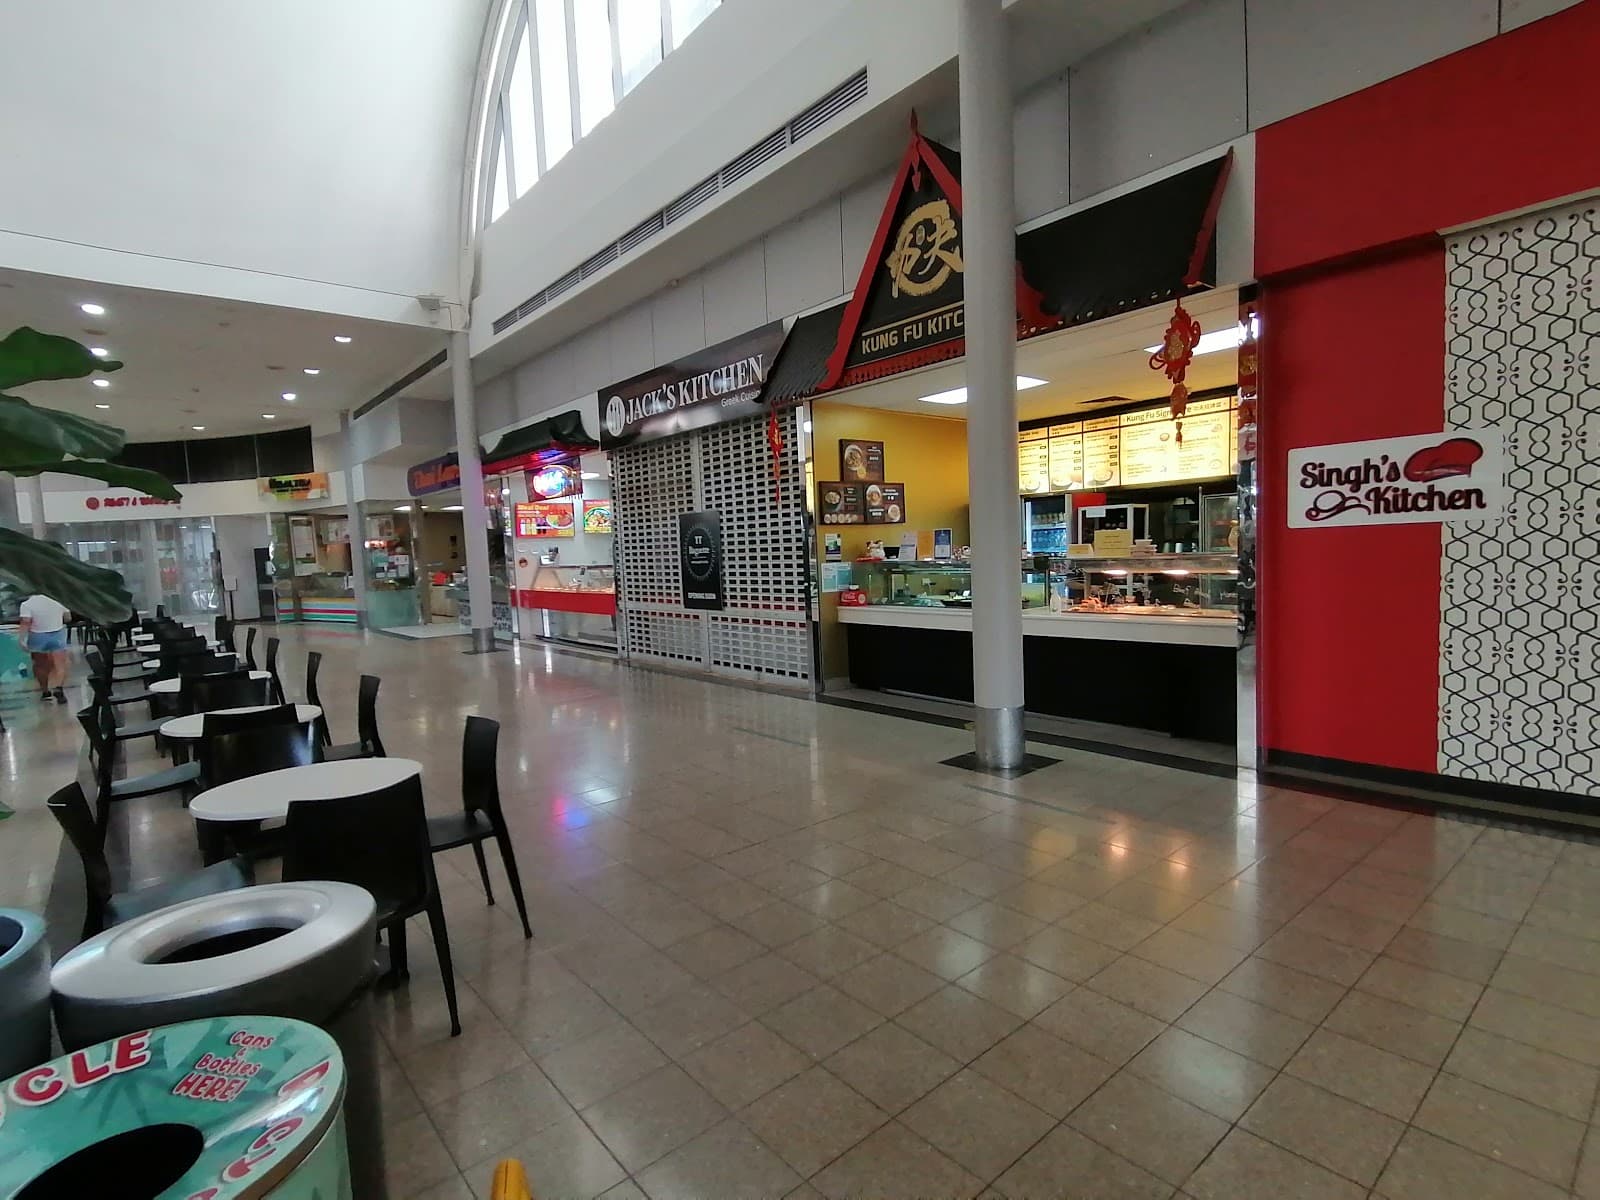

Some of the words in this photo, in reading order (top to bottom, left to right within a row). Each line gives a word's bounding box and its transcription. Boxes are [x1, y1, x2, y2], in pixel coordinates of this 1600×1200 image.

[862, 330, 898, 355] KUNG
[903, 321, 923, 343] FU
[928, 309, 964, 336] KITC
[626, 383, 675, 425] JACK'S
[679, 353, 763, 408] KITCHEN
[721, 395, 740, 408] Greek
[1126, 413, 1145, 423] Kung
[1145, 411, 1155, 419] Fu
[1300, 454, 1401, 493] Singh's
[1364, 484, 1487, 515] Kitchen
[230, 1030, 275, 1049] Cans
[0, 1030, 153, 1110] CLE
[195, 1053, 261, 1076] Bottles
[174, 1072, 249, 1100] HERE!
